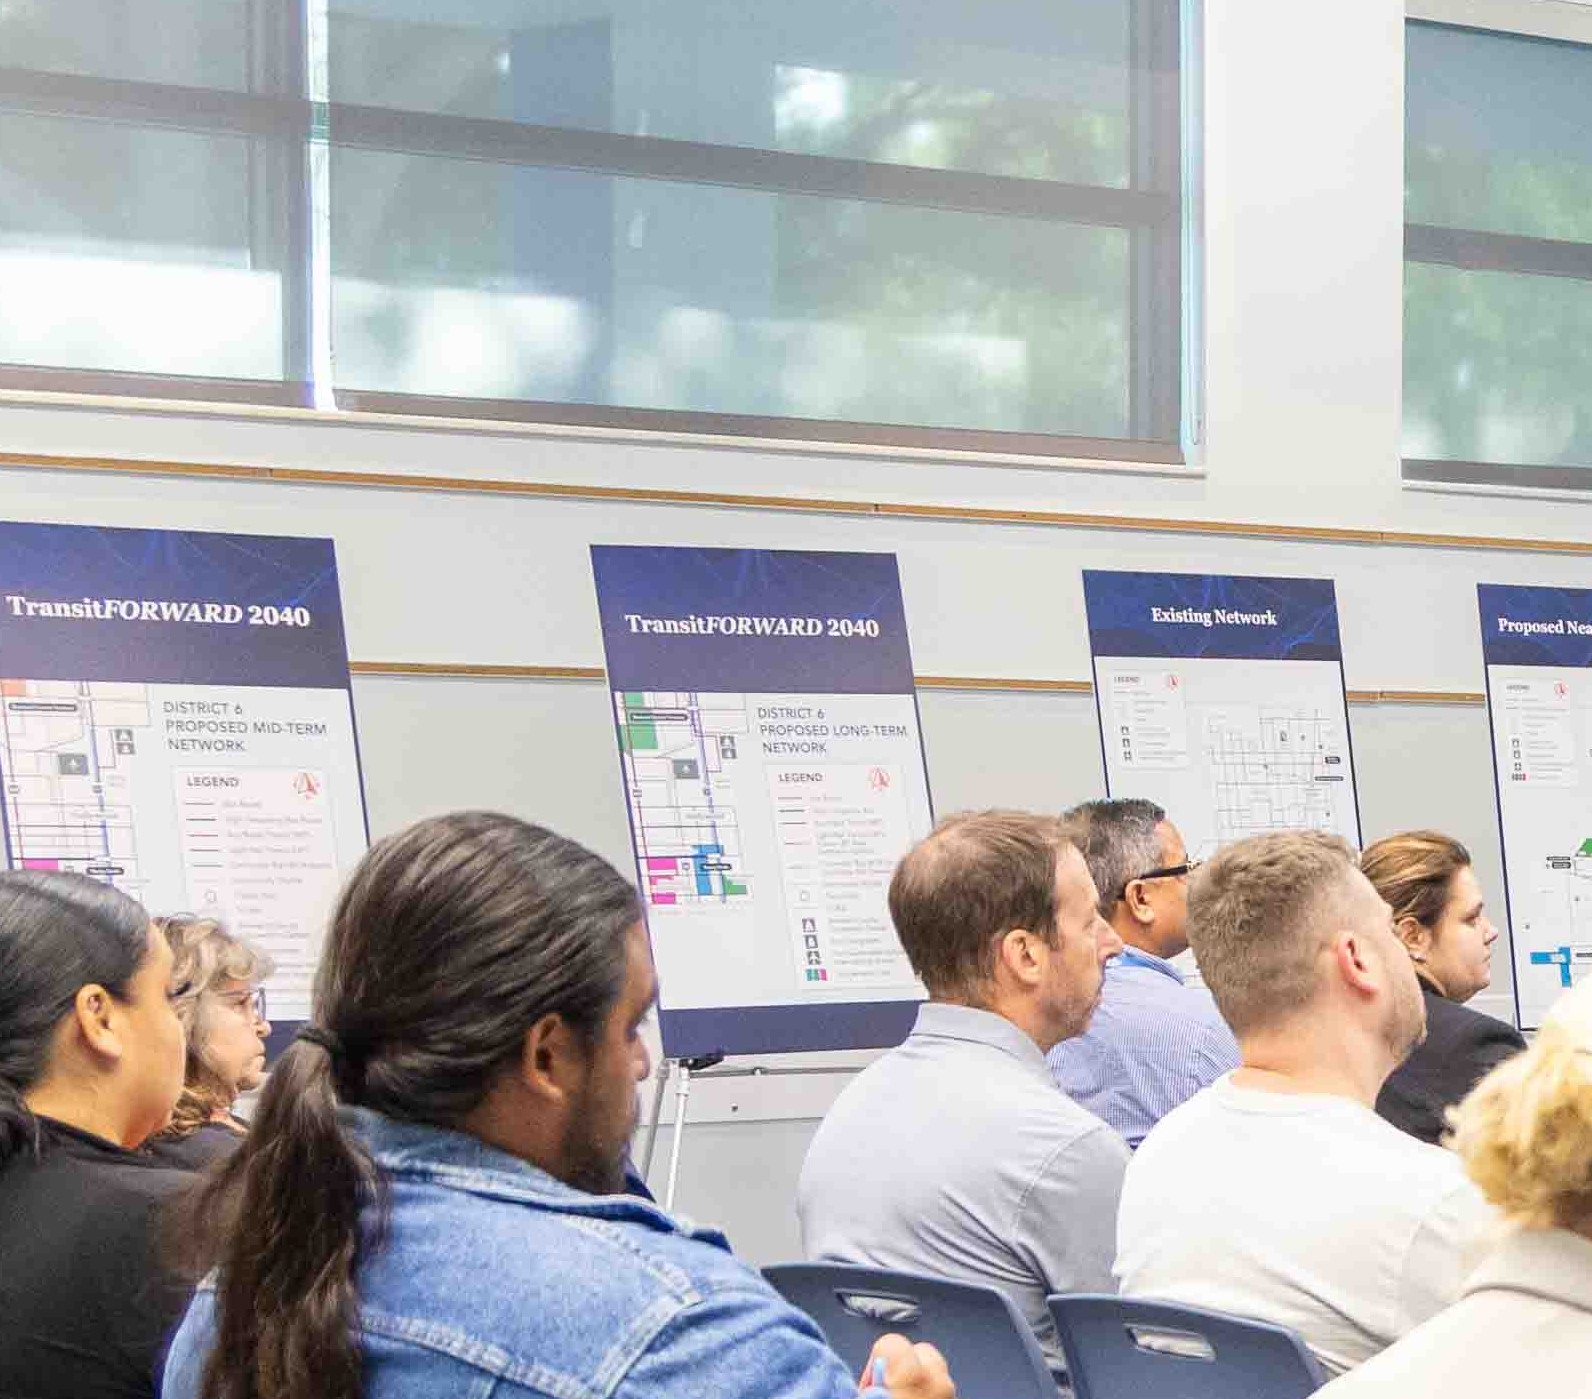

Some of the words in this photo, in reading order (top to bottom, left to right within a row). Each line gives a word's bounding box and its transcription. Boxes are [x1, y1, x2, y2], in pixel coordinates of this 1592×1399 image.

[6, 595, 244, 624] TransitFORWARD
[247, 603, 311, 628] 2040
[1151, 607, 1213, 627] Existing
[1214, 608, 1278, 626] Network
[625, 613, 823, 637] TransitFORWARD
[827, 618, 880, 640] 2040
[1497, 617, 1564, 637] Proposed
[163, 701, 229, 715] DISTRICT
[234, 703, 244, 715] 6
[757, 706, 812, 720] DISTRICT
[817, 708, 826, 719] 6
[165, 719, 249, 734] PROPOSED
[253, 721, 327, 735] MID-TERM
[760, 724, 829, 737] PROPOSED
[832, 724, 908, 738] LONG-TERM
[167, 738, 246, 752] NETWORK
[762, 741, 827, 754] NETWORK
[186, 776, 240, 788] LEGEND
[778, 772, 824, 783] LEGEND
